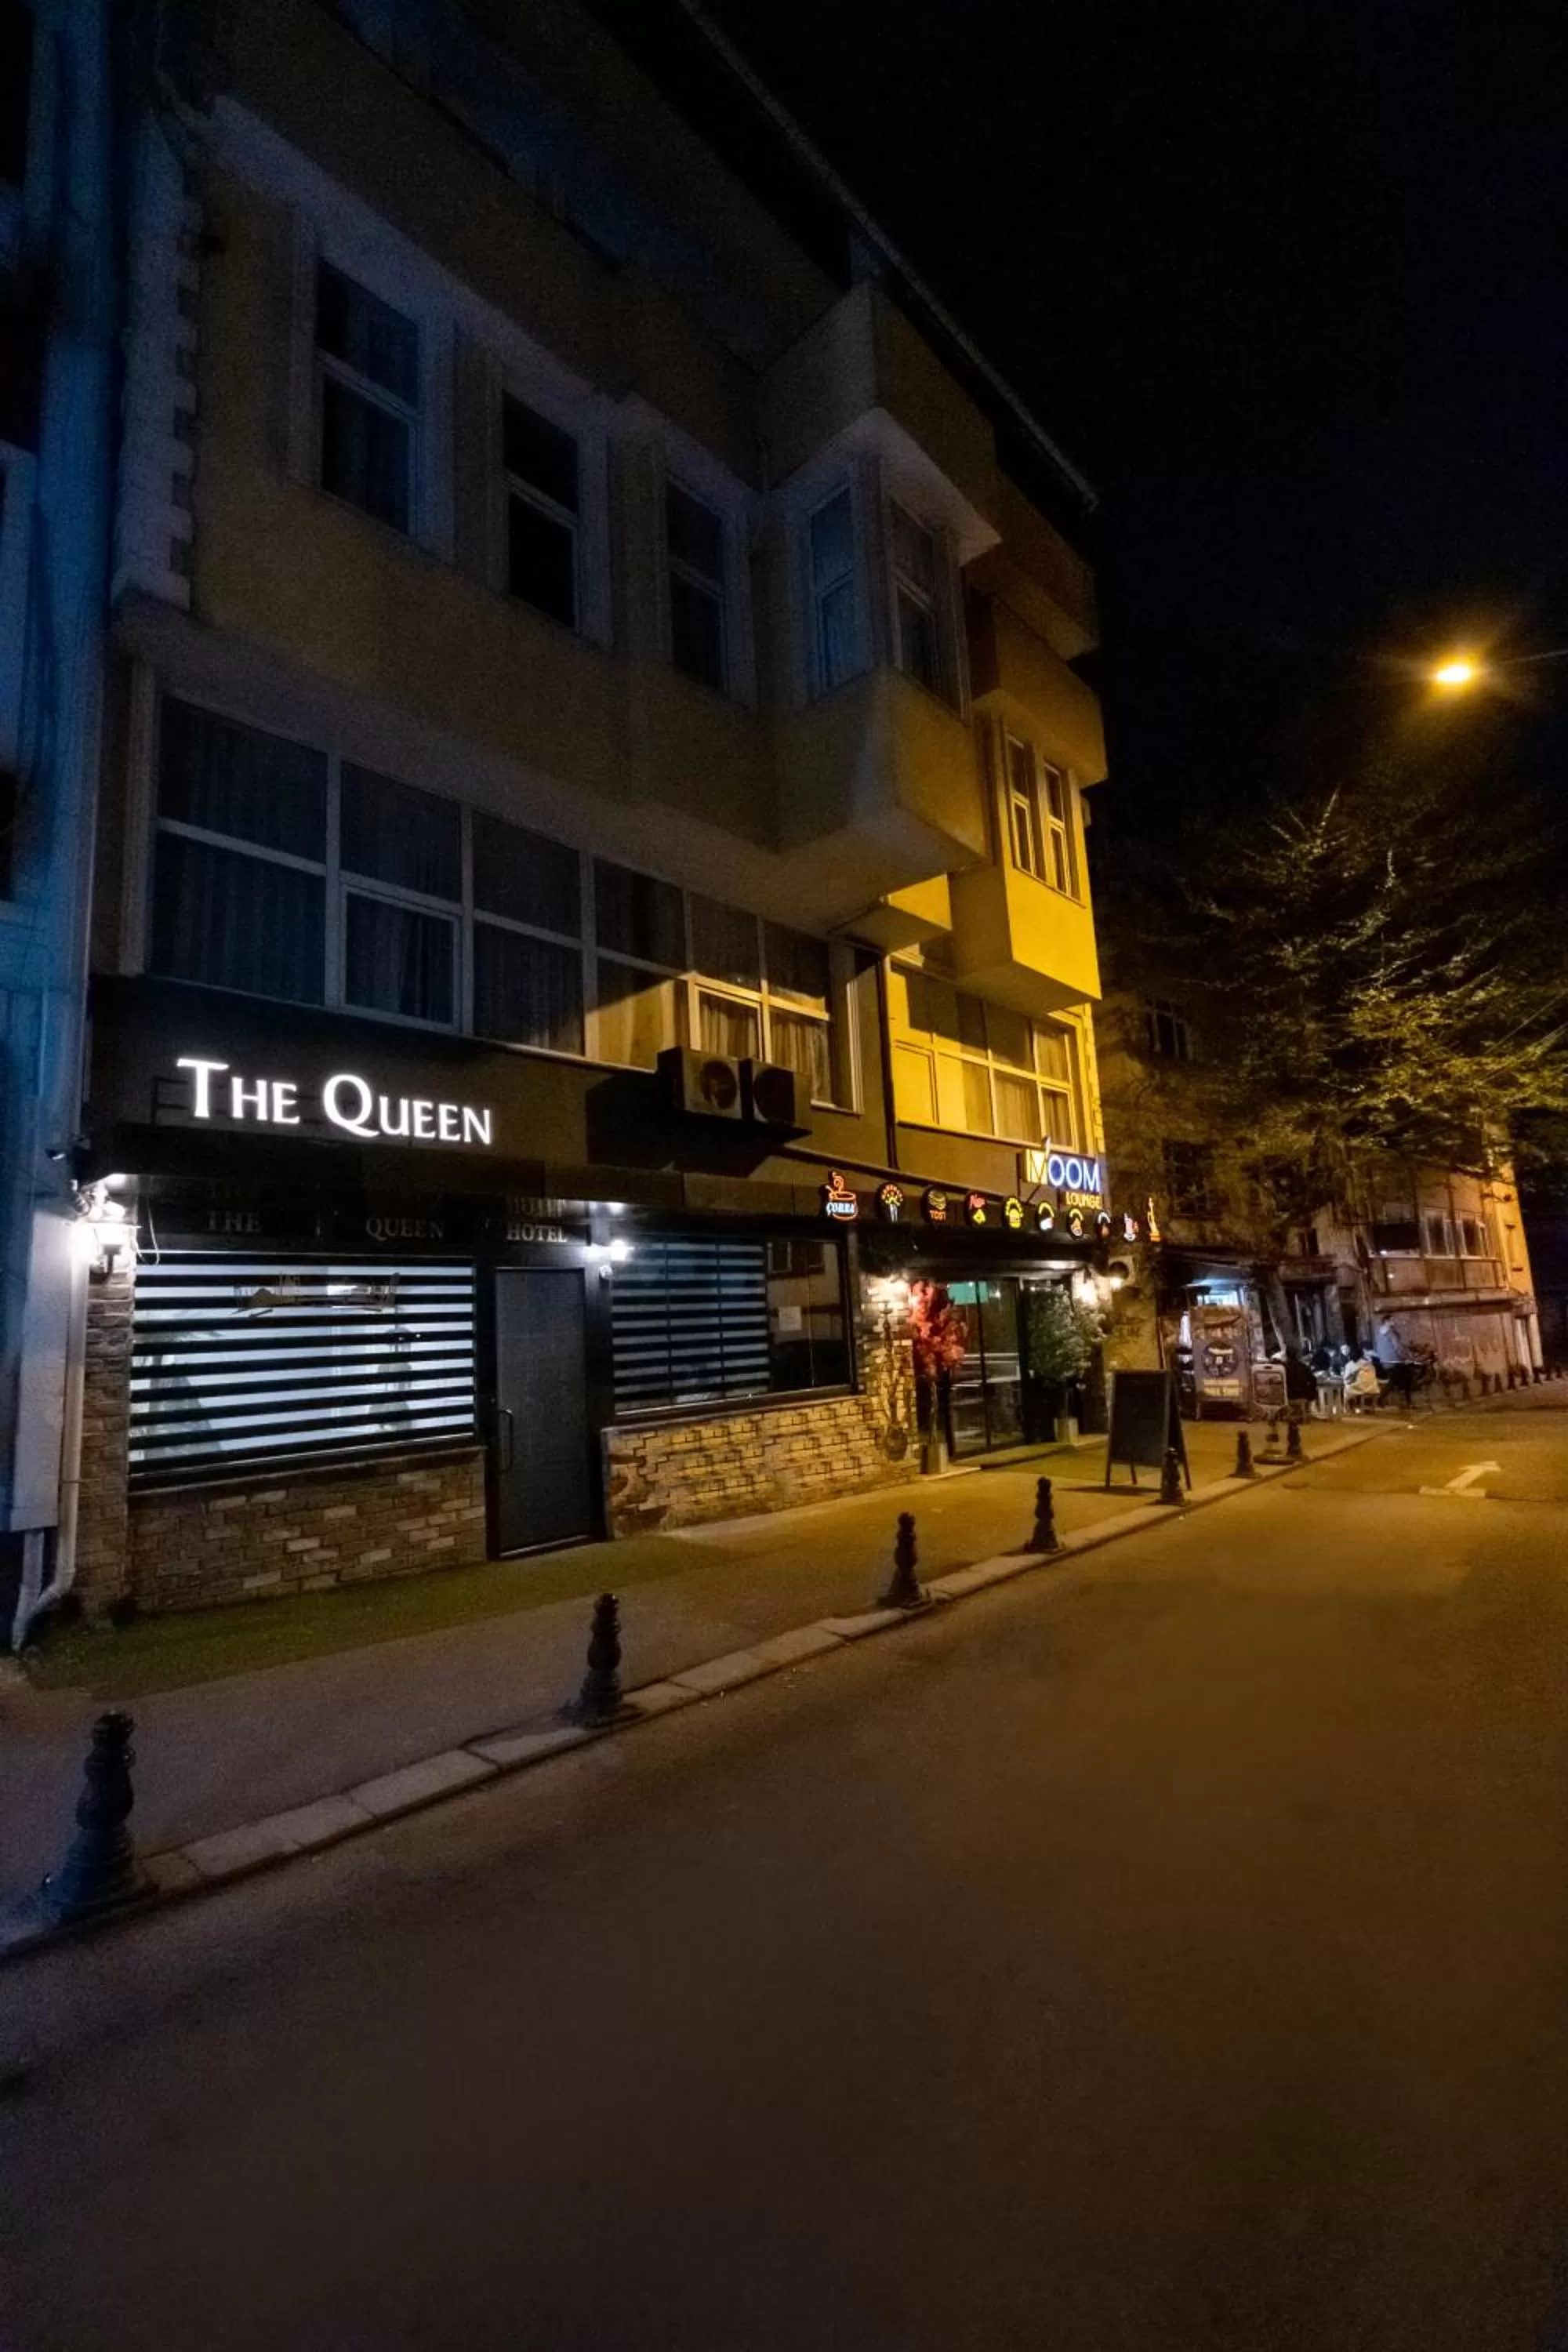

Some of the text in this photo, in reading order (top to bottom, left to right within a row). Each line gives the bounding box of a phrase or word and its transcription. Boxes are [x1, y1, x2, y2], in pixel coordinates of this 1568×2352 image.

[1065, 1191, 1104, 1210] LOUNGE
[207, 1210, 568, 1243] THE QUEEN HOTEL
